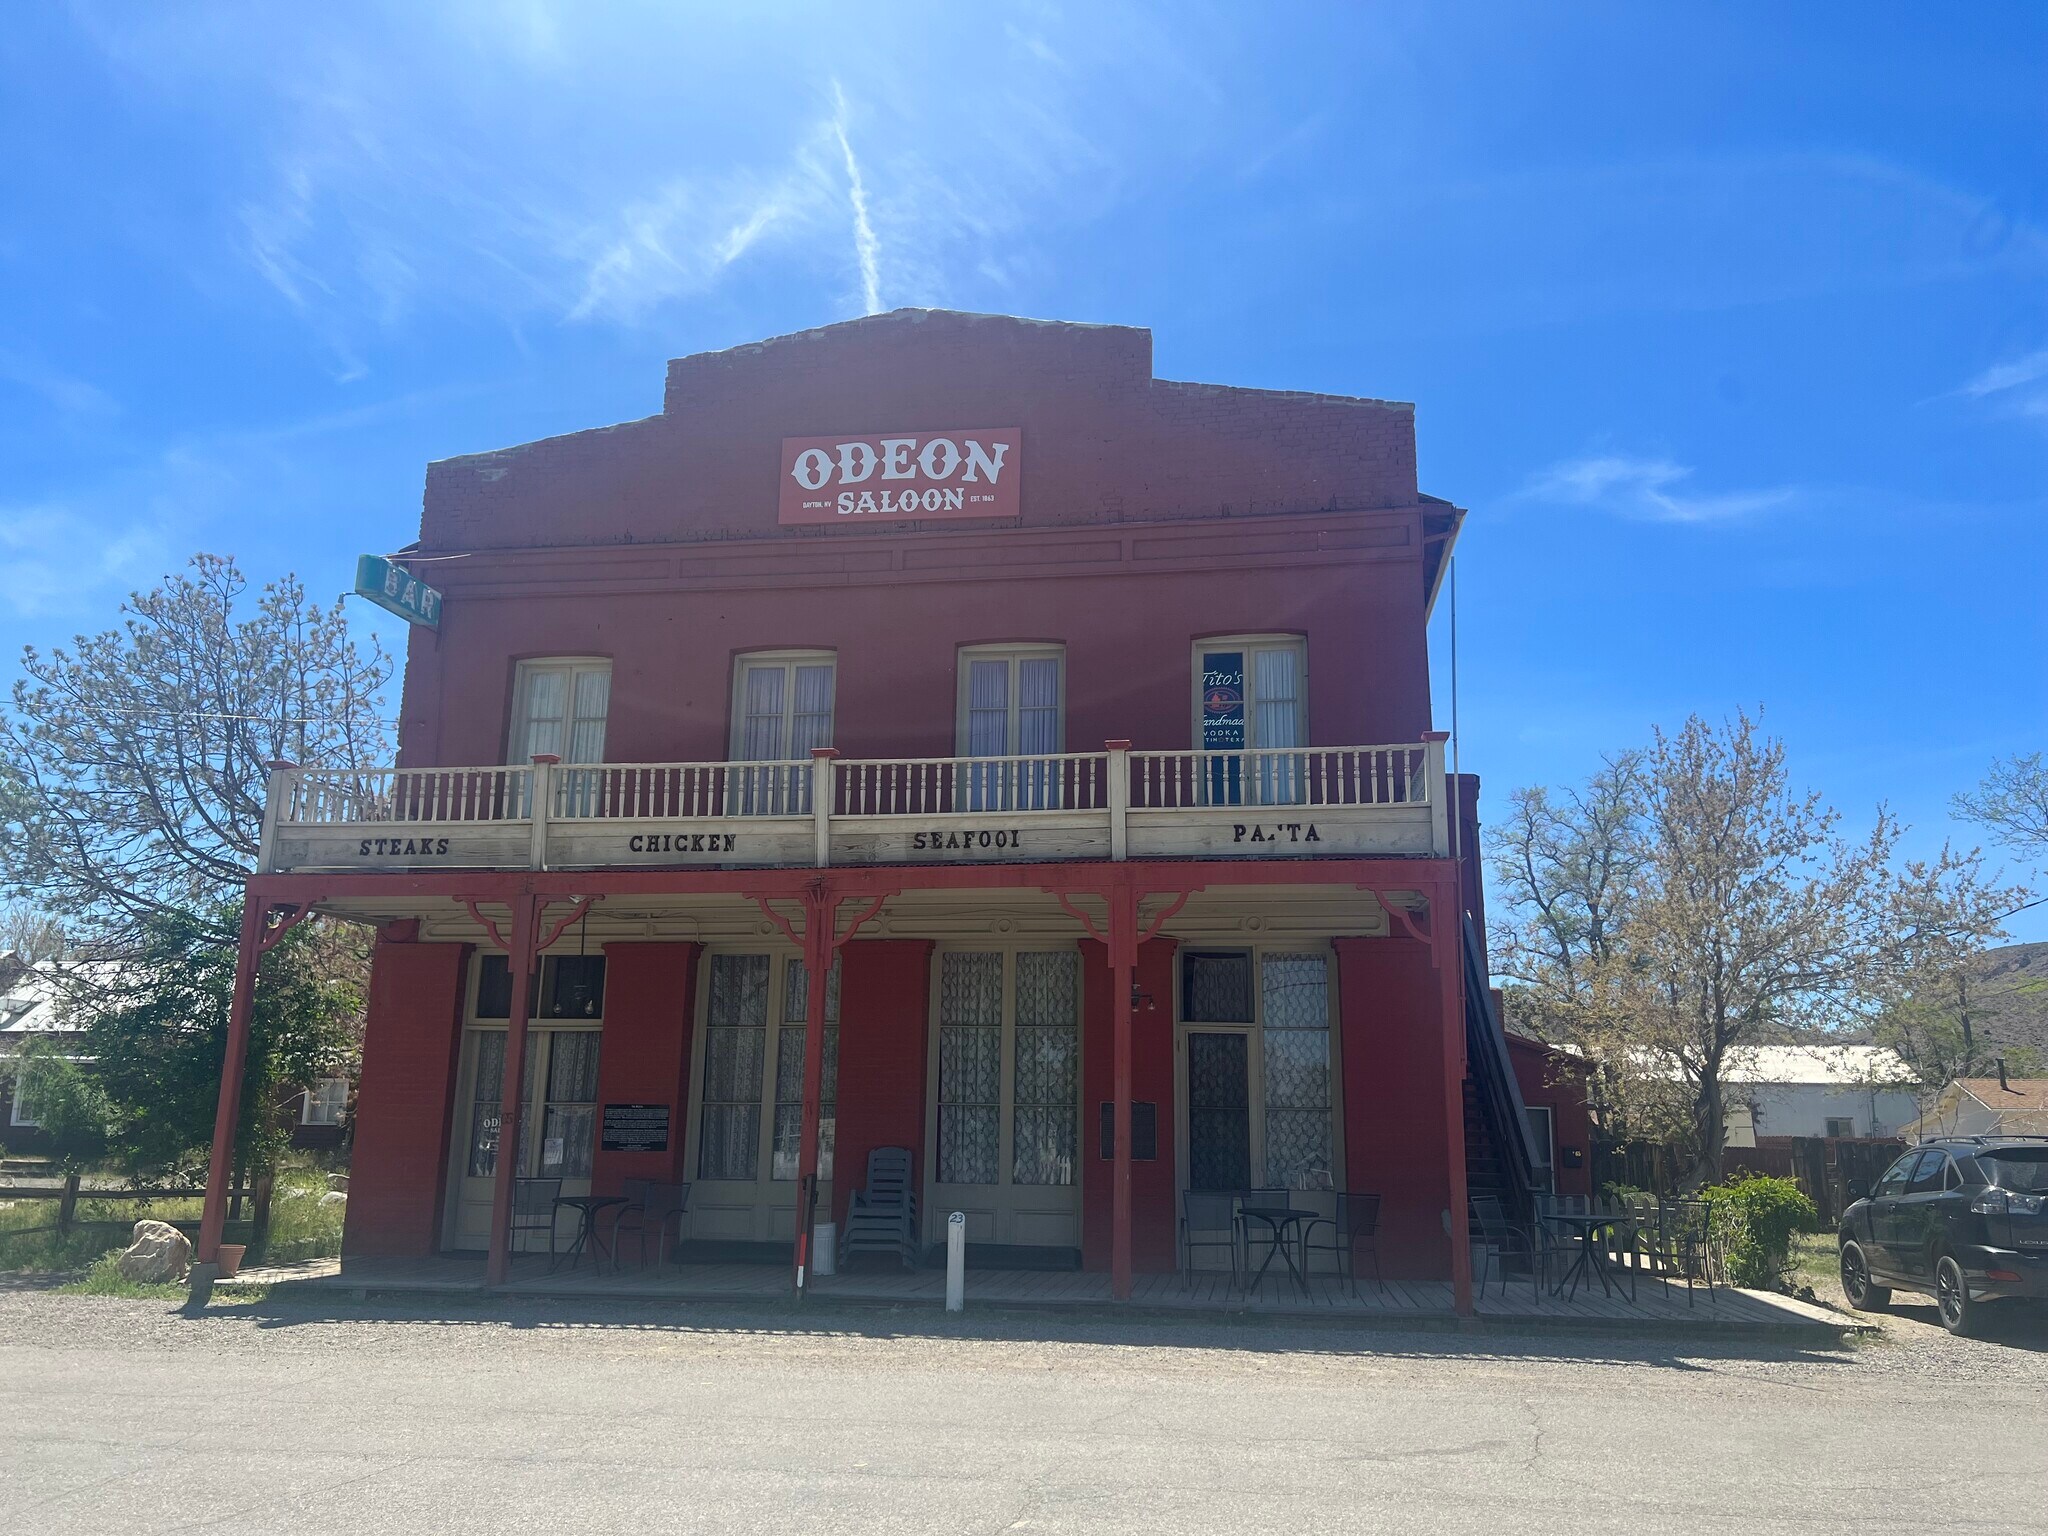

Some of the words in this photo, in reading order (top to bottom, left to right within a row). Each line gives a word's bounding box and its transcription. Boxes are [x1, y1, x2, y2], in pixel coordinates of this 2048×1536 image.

[791, 438, 1010, 490] ODEON
[824, 500, 832, 508] NV
[837, 487, 965, 514] SALOON
[982, 494, 995, 502] 1863
[384, 566, 435, 619] BAR
[1203, 670, 1243, 686] Tito's
[1203, 729, 1239, 737] VODKA
[1233, 823, 1320, 842] PATA
[359, 838, 449, 856] STEAKS
[629, 834, 736, 852] CHICKEN
[949, 1214, 963, 1224] 23
